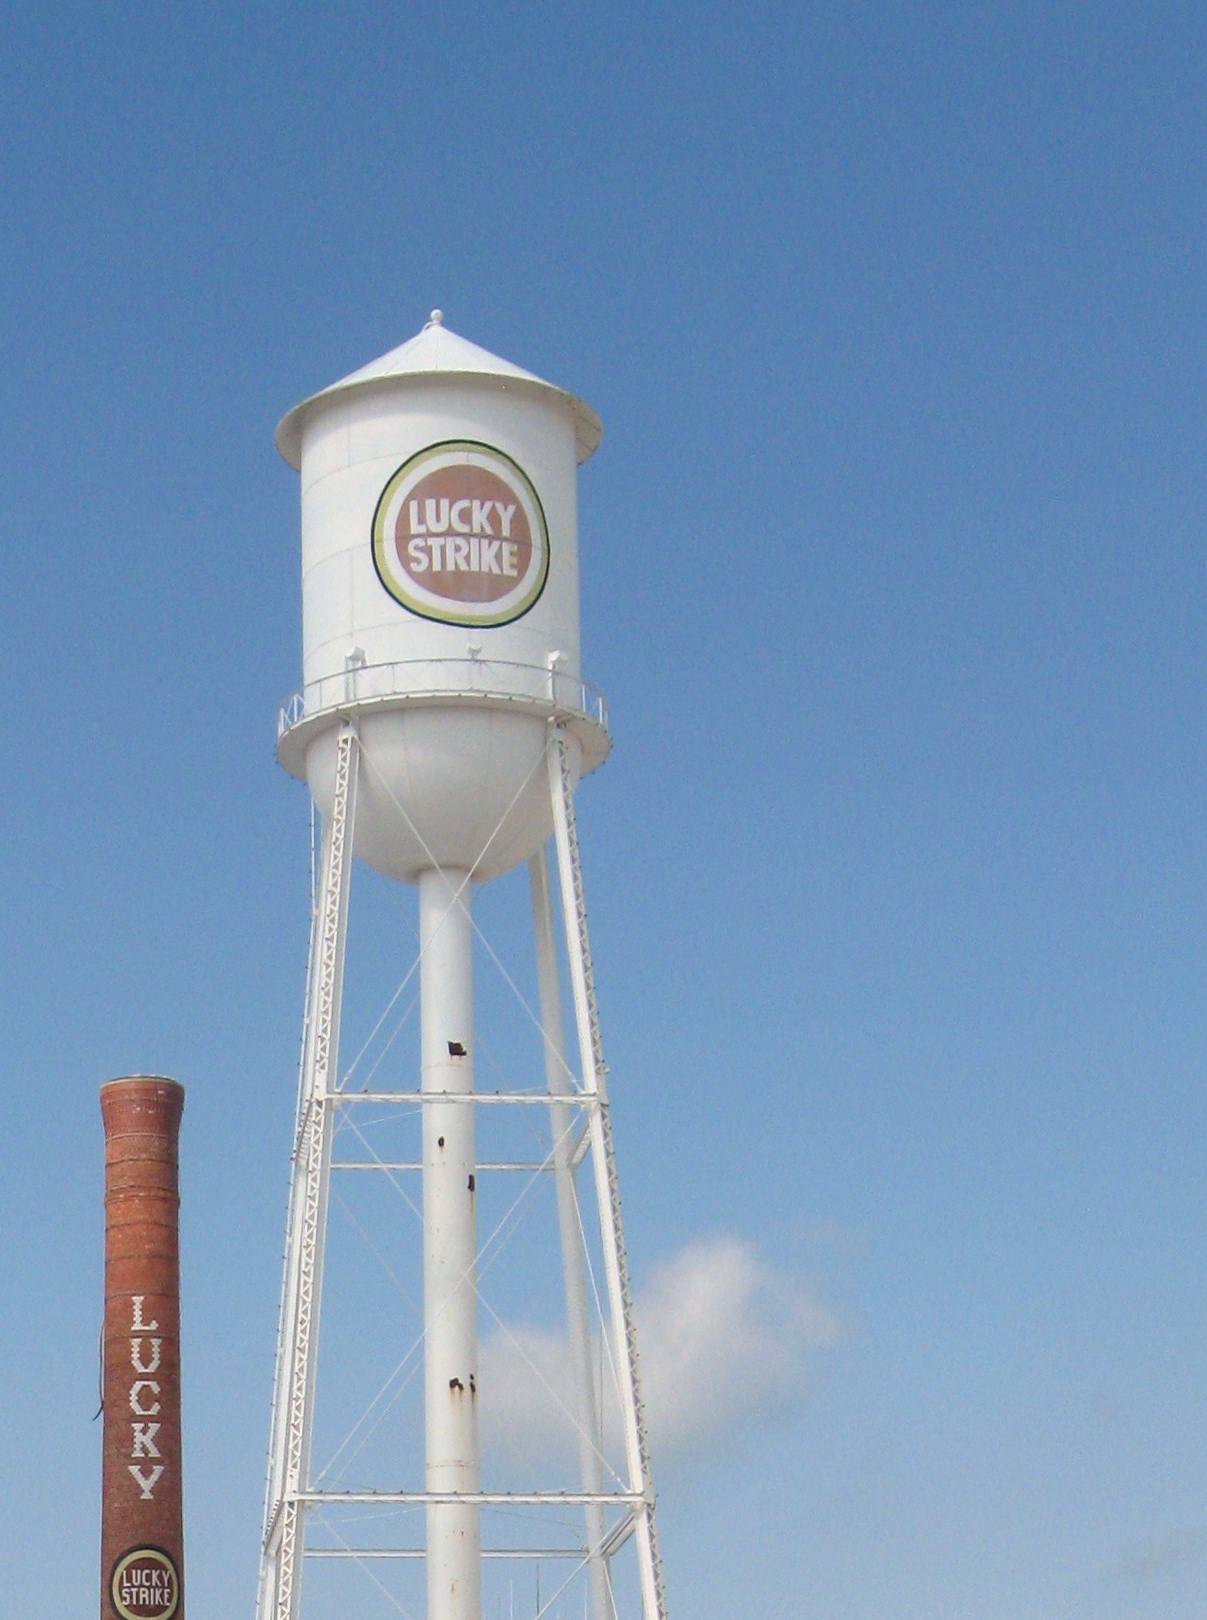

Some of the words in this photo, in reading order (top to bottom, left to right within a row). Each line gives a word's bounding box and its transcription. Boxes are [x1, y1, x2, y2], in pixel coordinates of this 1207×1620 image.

[408, 498, 516, 536] LUCKY
[407, 536, 518, 577] STRIKE
[127, 1295, 165, 1500] LUCKY
[121, 1587, 171, 1606] STRIKE
[122, 1568, 171, 1587] LUCKY
